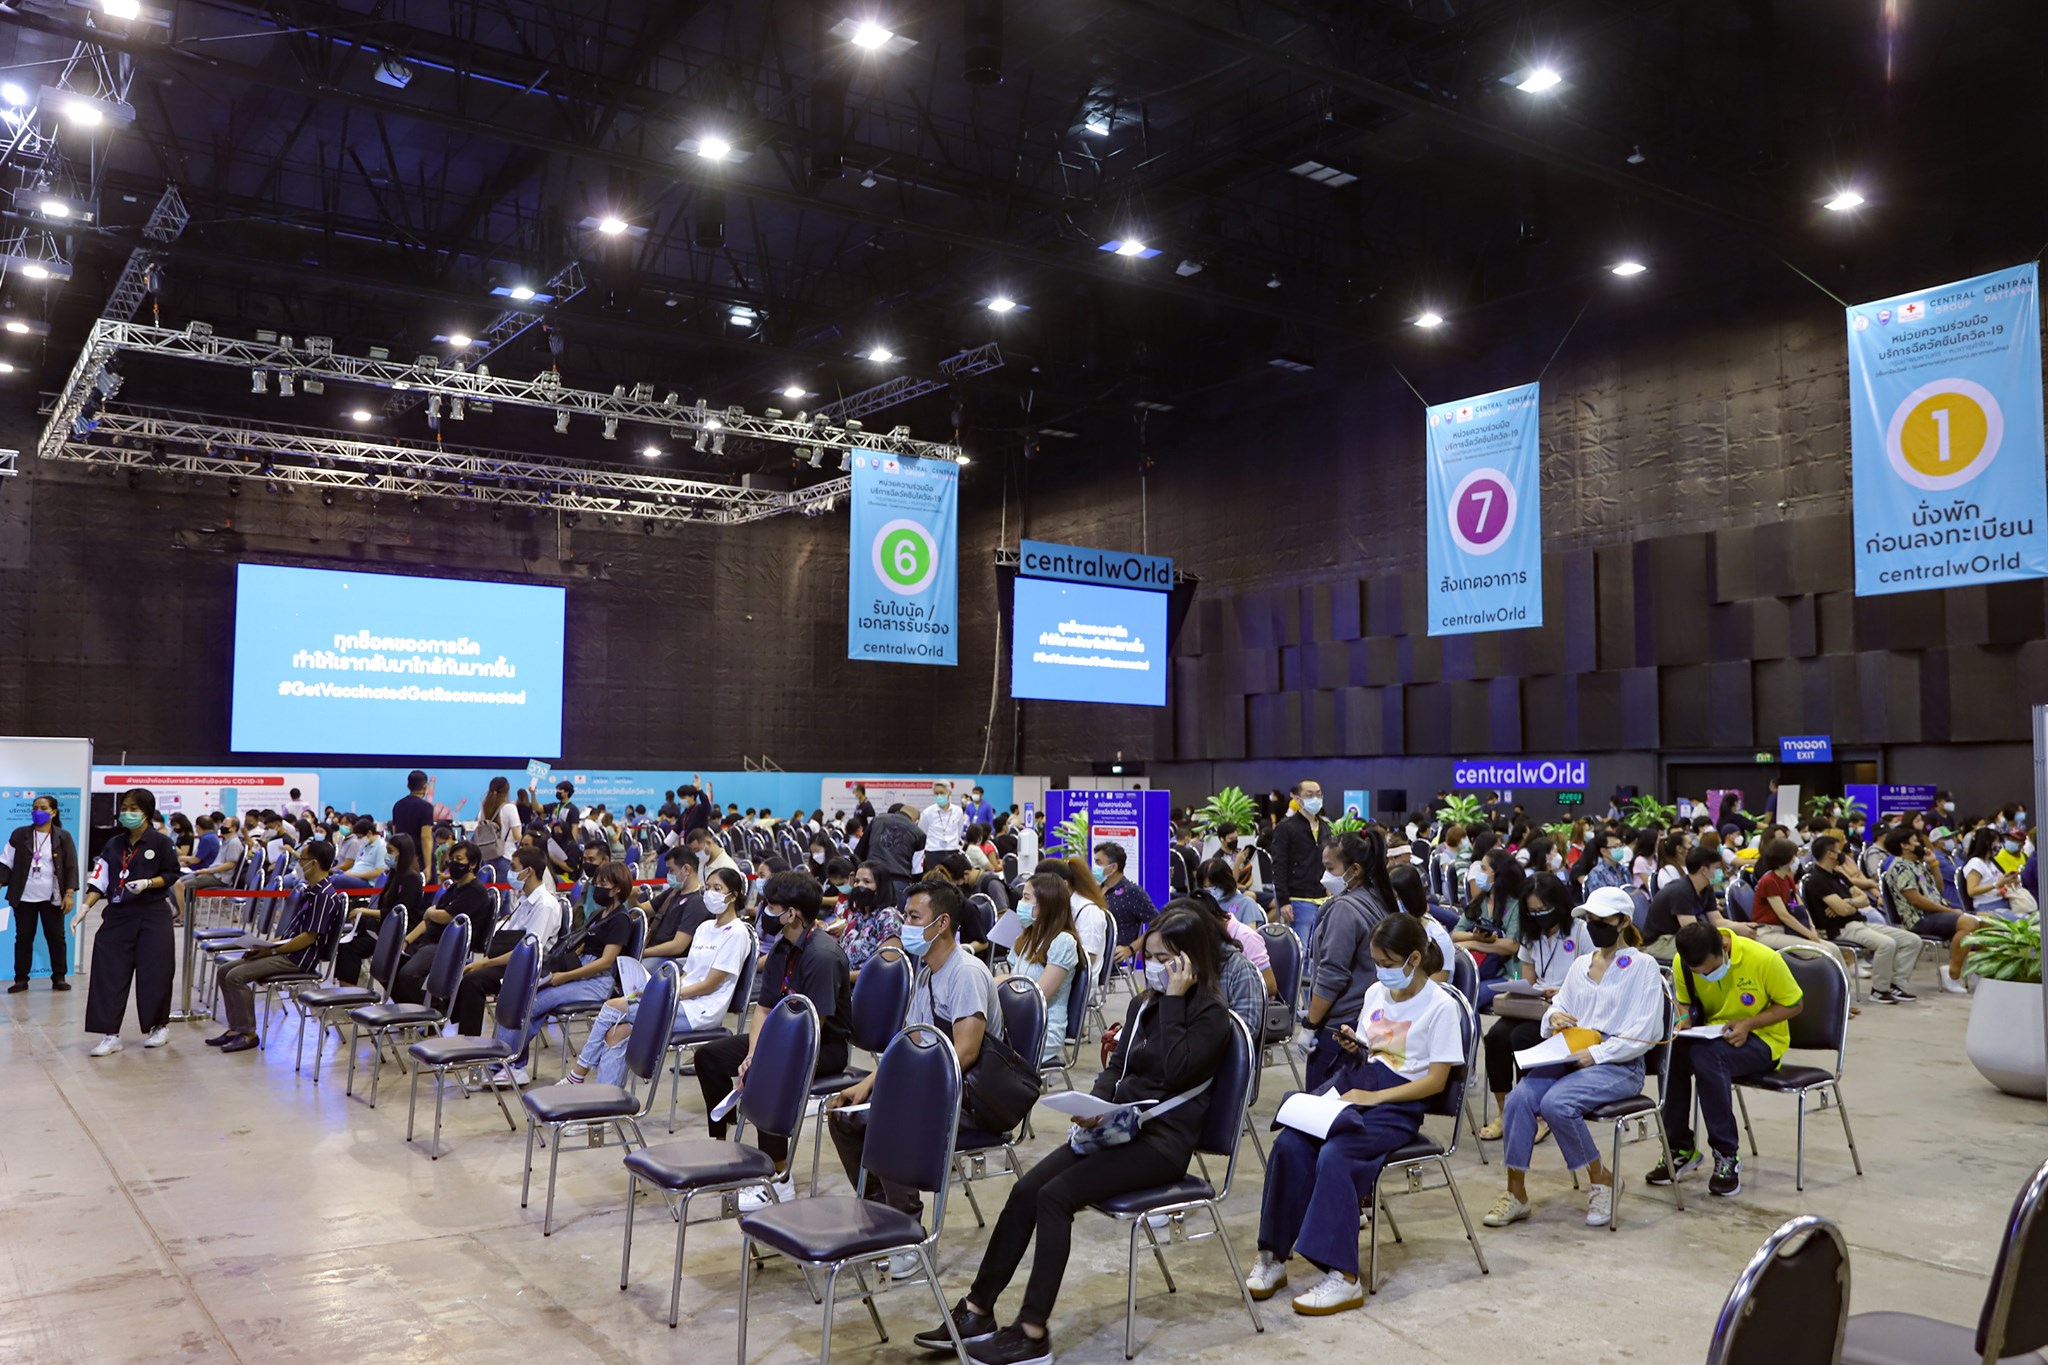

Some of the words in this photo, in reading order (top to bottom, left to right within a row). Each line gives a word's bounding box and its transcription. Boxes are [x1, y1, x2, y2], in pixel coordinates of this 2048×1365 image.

[1983, 275, 2034, 295] CENTRAL
[1929, 290, 1976, 308] CENTRAL
[1935, 299, 1972, 315] GROUP
[1891, 314, 1989, 344] หน่วยความร่วมมือ
[1475, 402, 1503, 412] CENTRAL
[1931, 408, 1950, 462] 1
[1471, 490, 1493, 534] 7
[1912, 499, 1980, 527] นั่งพัก
[1866, 517, 2033, 555] ก่อนลงทะเบียน
[894, 539, 917, 576] 6
[1025, 552, 1169, 585] centralwOrld
[1879, 552, 2021, 584] centralwOrld
[1440, 570, 1527, 593] สังเกตอาการ
[873, 599, 924, 618] รับใบนัด
[928, 604, 935, 621] /
[1442, 605, 1526, 627] centralwOrld
[858, 615, 949, 635] เอกสารรับรอง
[863, 643, 944, 658] centralwOrld
[278, 680, 526, 705] #GetVaccinatedGetReconnected
[1784, 739, 1827, 750] ทางออก
[1797, 751, 1815, 760] EXIT
[1455, 761, 1585, 784] centralwOrld
